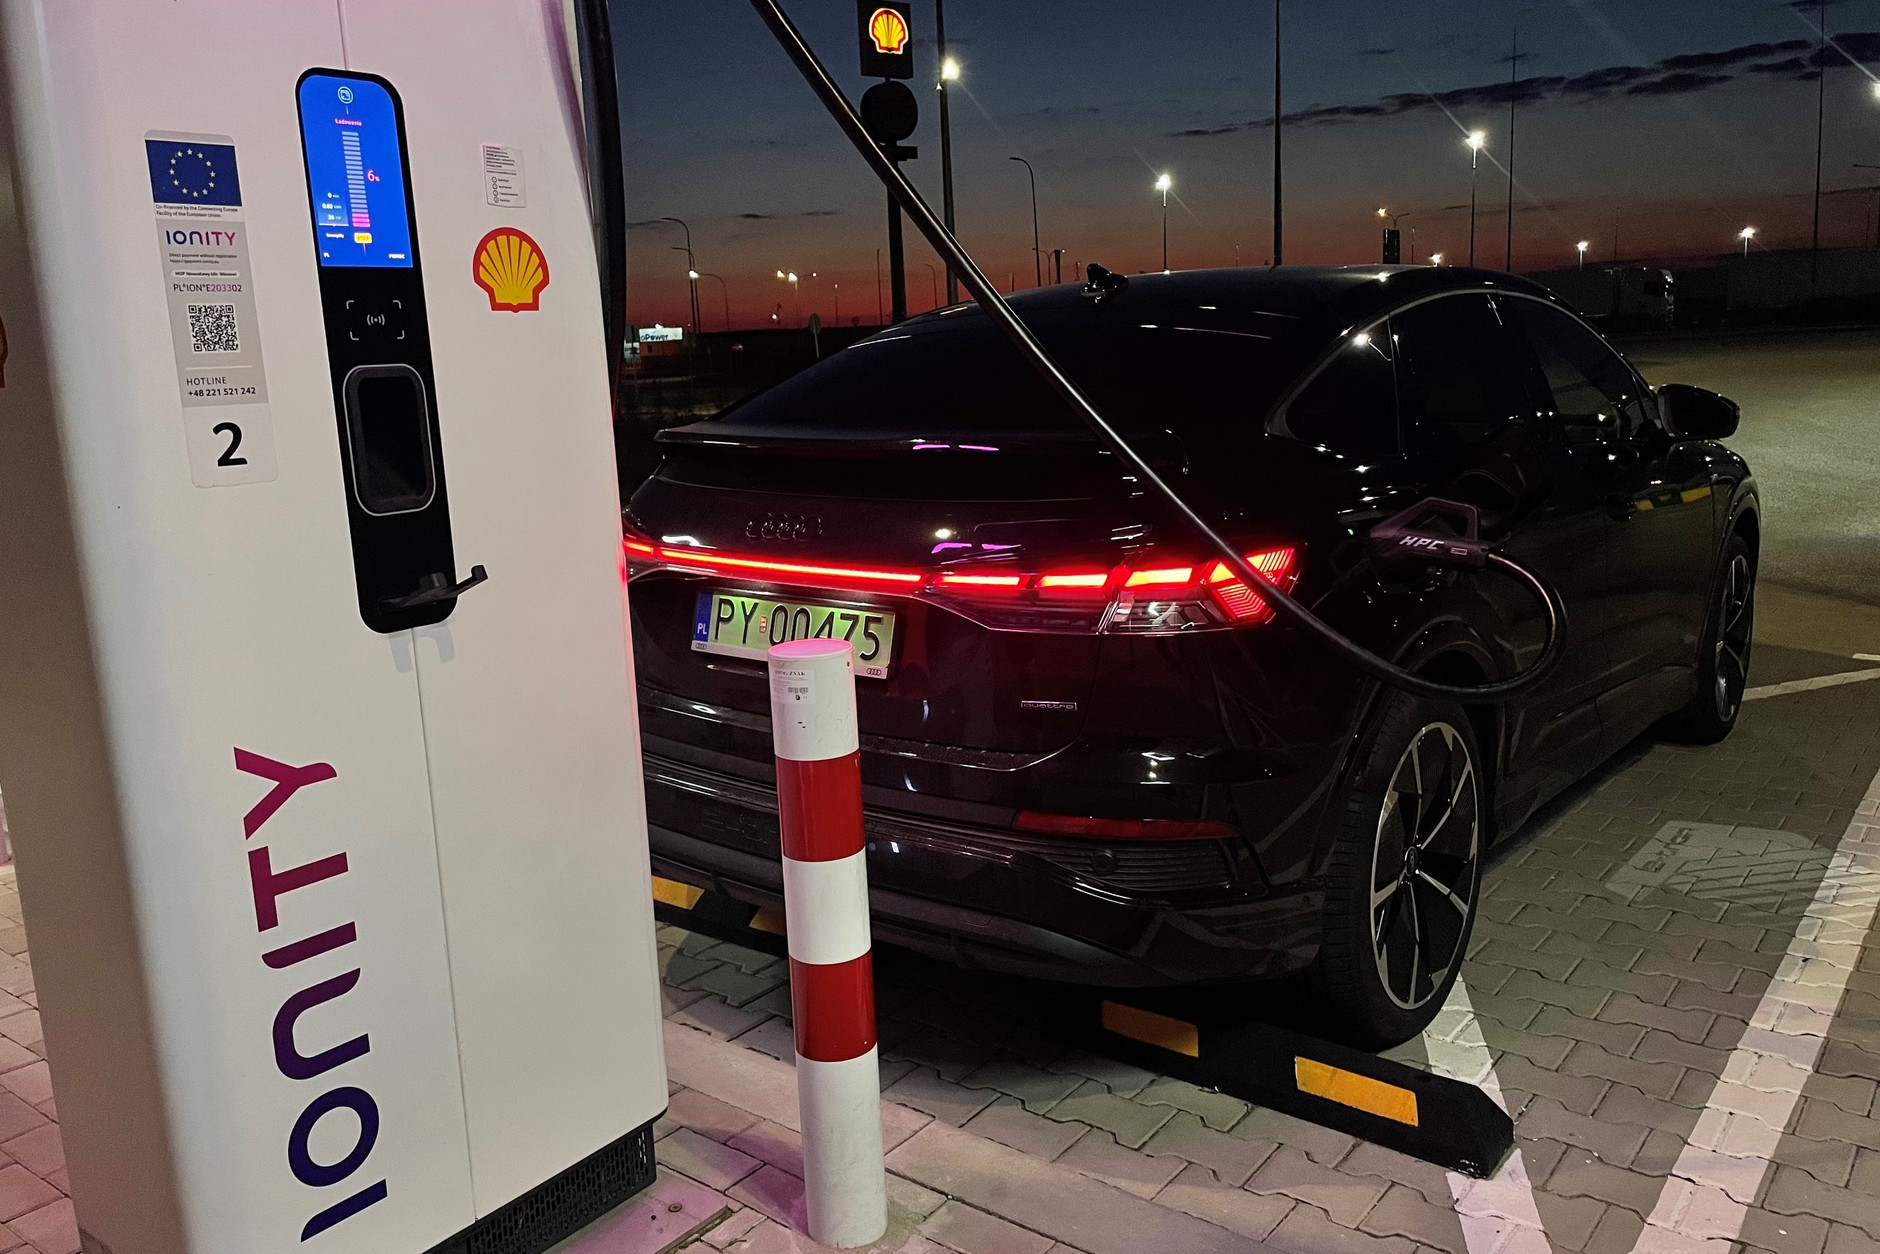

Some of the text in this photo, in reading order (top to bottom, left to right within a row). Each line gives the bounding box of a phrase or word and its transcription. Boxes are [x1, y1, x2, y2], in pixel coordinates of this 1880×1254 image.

[166, 230, 236, 246] IONITY
[186, 376, 227, 386] HOTLINE
[188, 387, 256, 397] +48 221 521 242
[212, 421, 248, 467] 2
[1399, 535, 1445, 550] HPC
[714, 597, 759, 644] PY
[697, 622, 708, 635] PL
[233, 746, 388, 1243] IONITY
